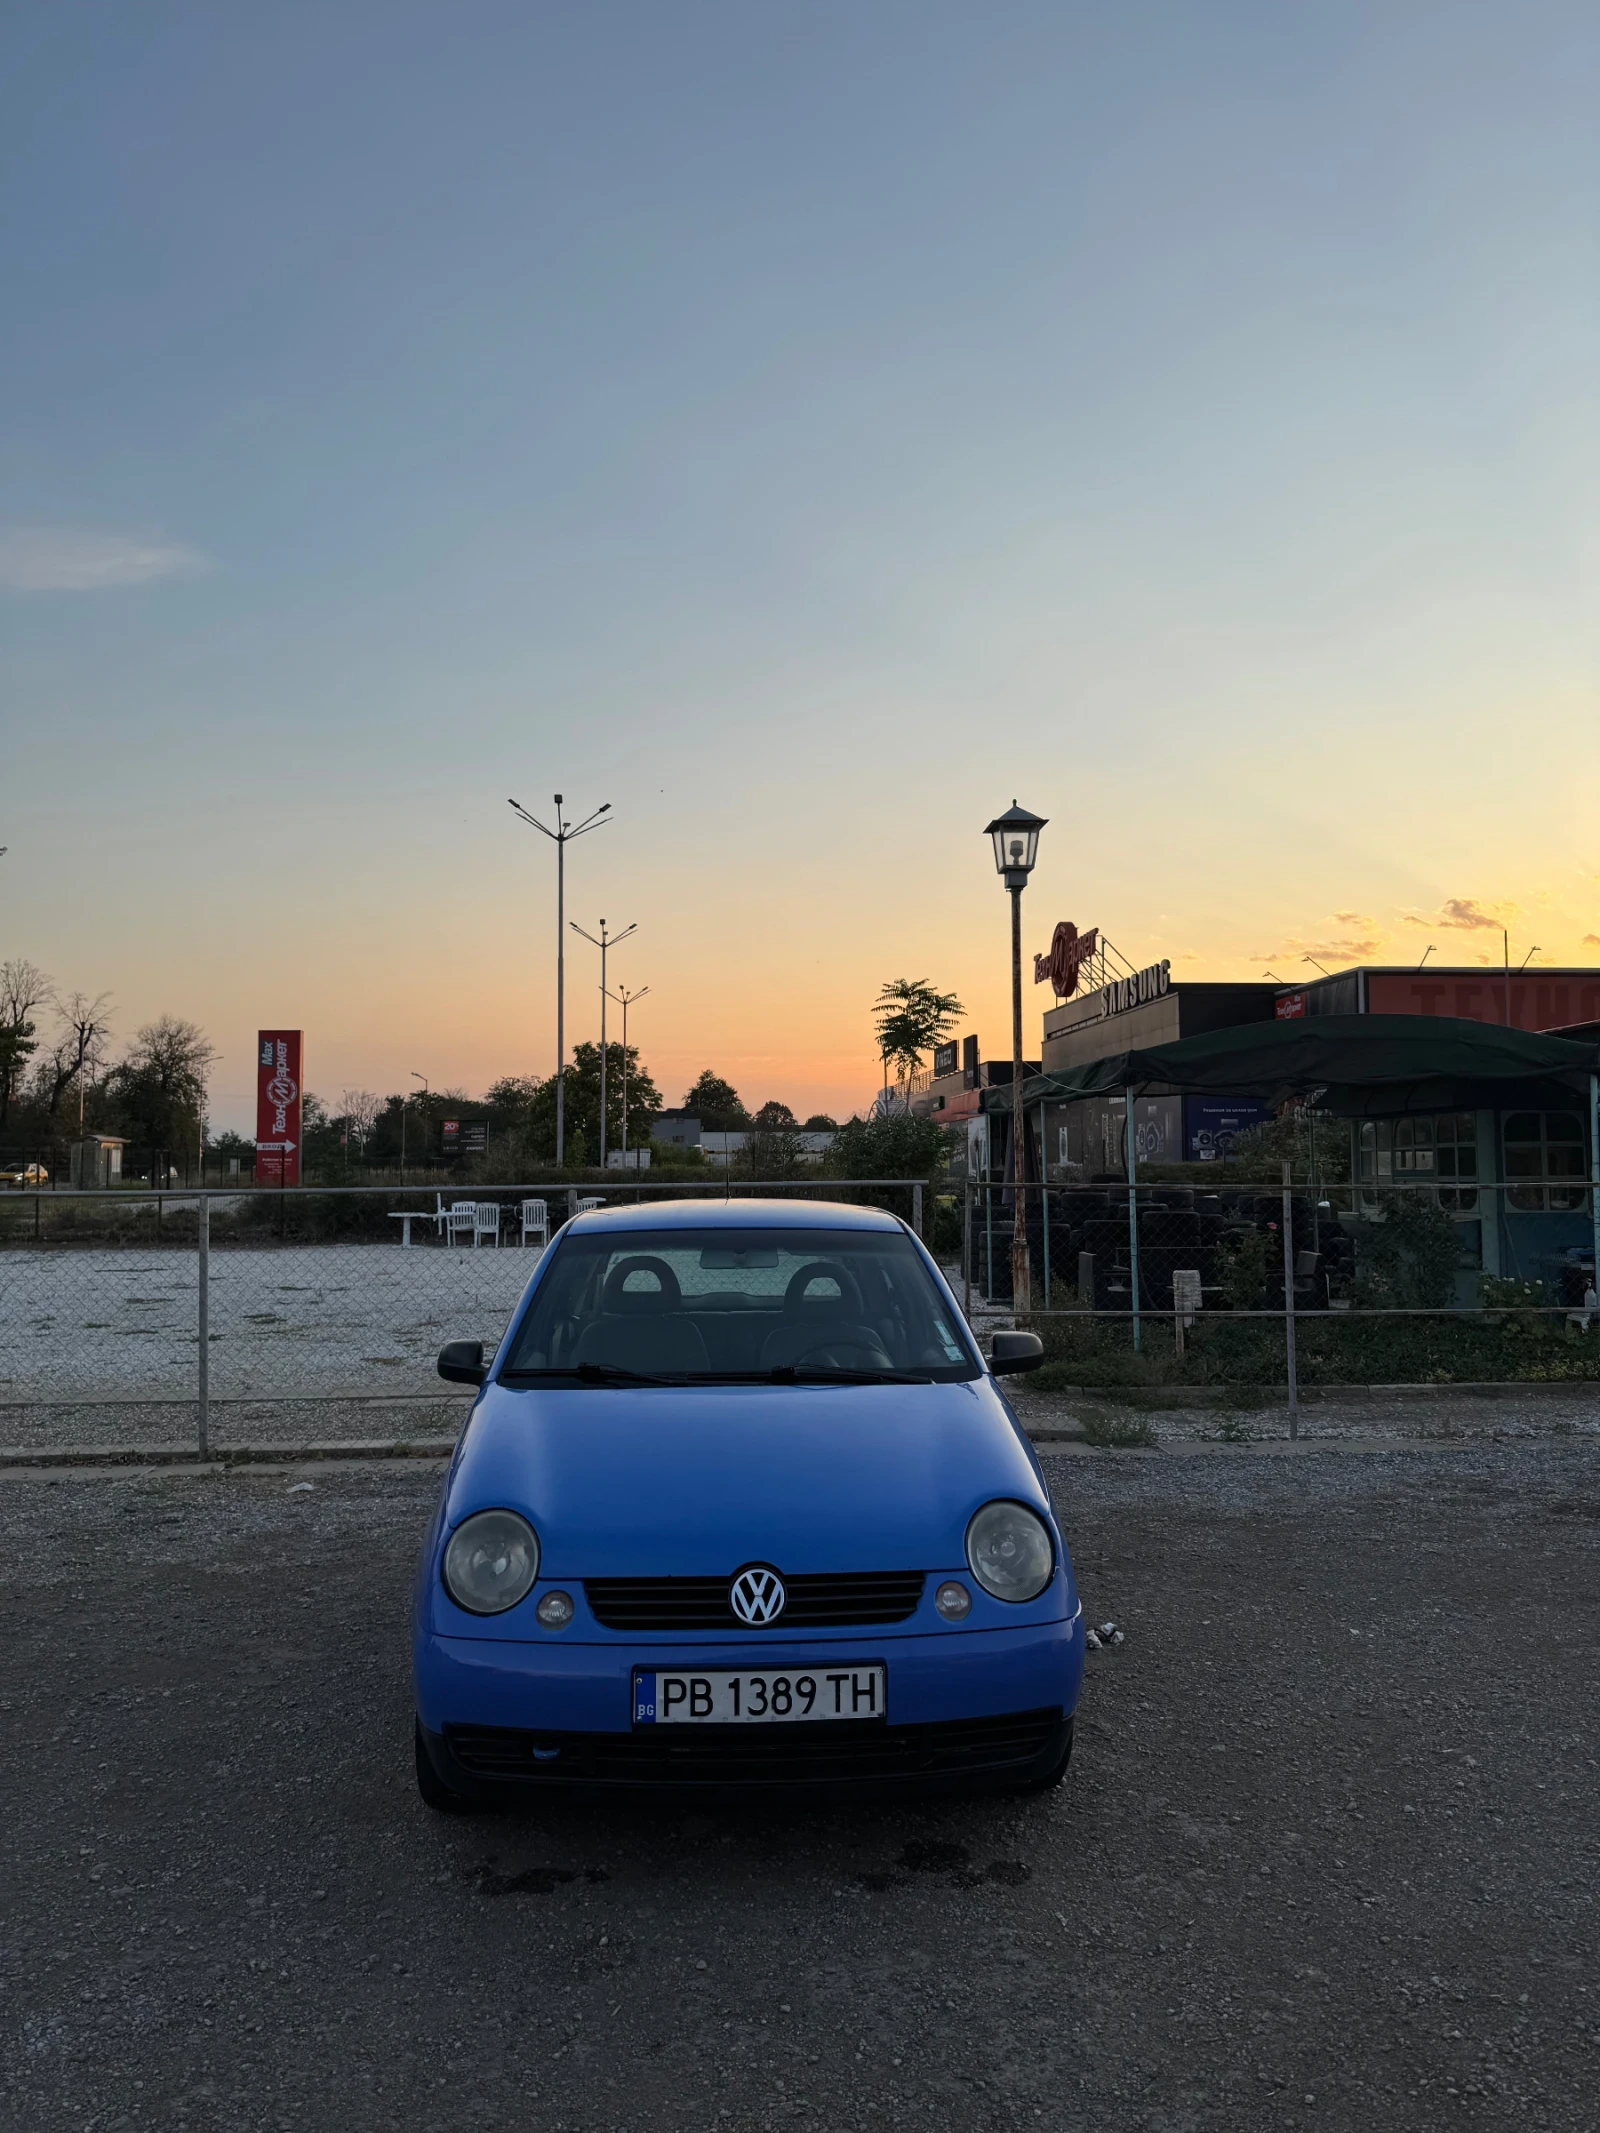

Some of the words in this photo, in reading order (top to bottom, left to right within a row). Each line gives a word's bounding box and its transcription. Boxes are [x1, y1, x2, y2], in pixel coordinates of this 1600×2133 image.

[1101, 959, 1171, 1018] SAMSUNG
[262, 1041, 273, 1066] Max
[638, 1704, 654, 1716] BG
[663, 1678, 713, 1717] PB
[728, 1676, 817, 1717] 1389
[826, 1672, 876, 1713] TH
